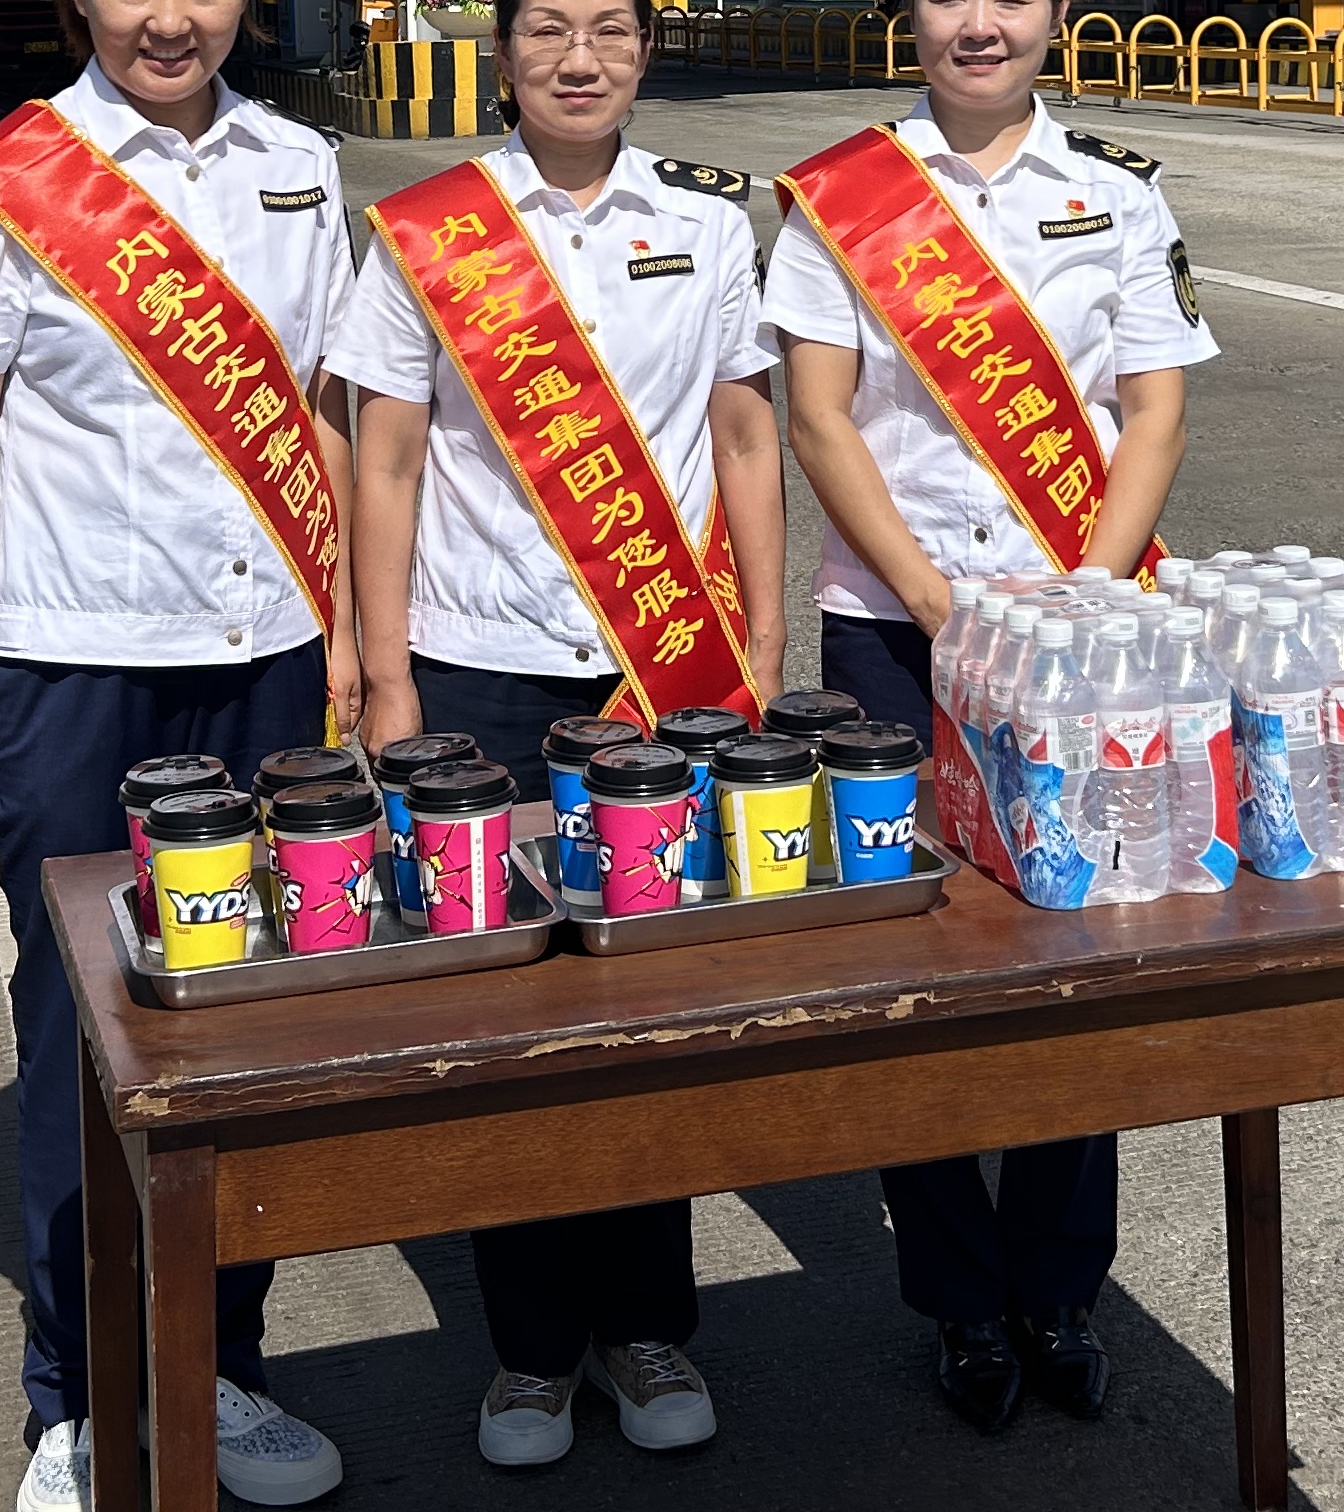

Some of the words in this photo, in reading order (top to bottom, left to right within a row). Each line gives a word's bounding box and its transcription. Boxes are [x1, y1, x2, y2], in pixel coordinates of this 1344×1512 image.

[428, 210, 705, 665] 内蒙古交通集团为您服务
[849, 815, 915, 848] YYD
